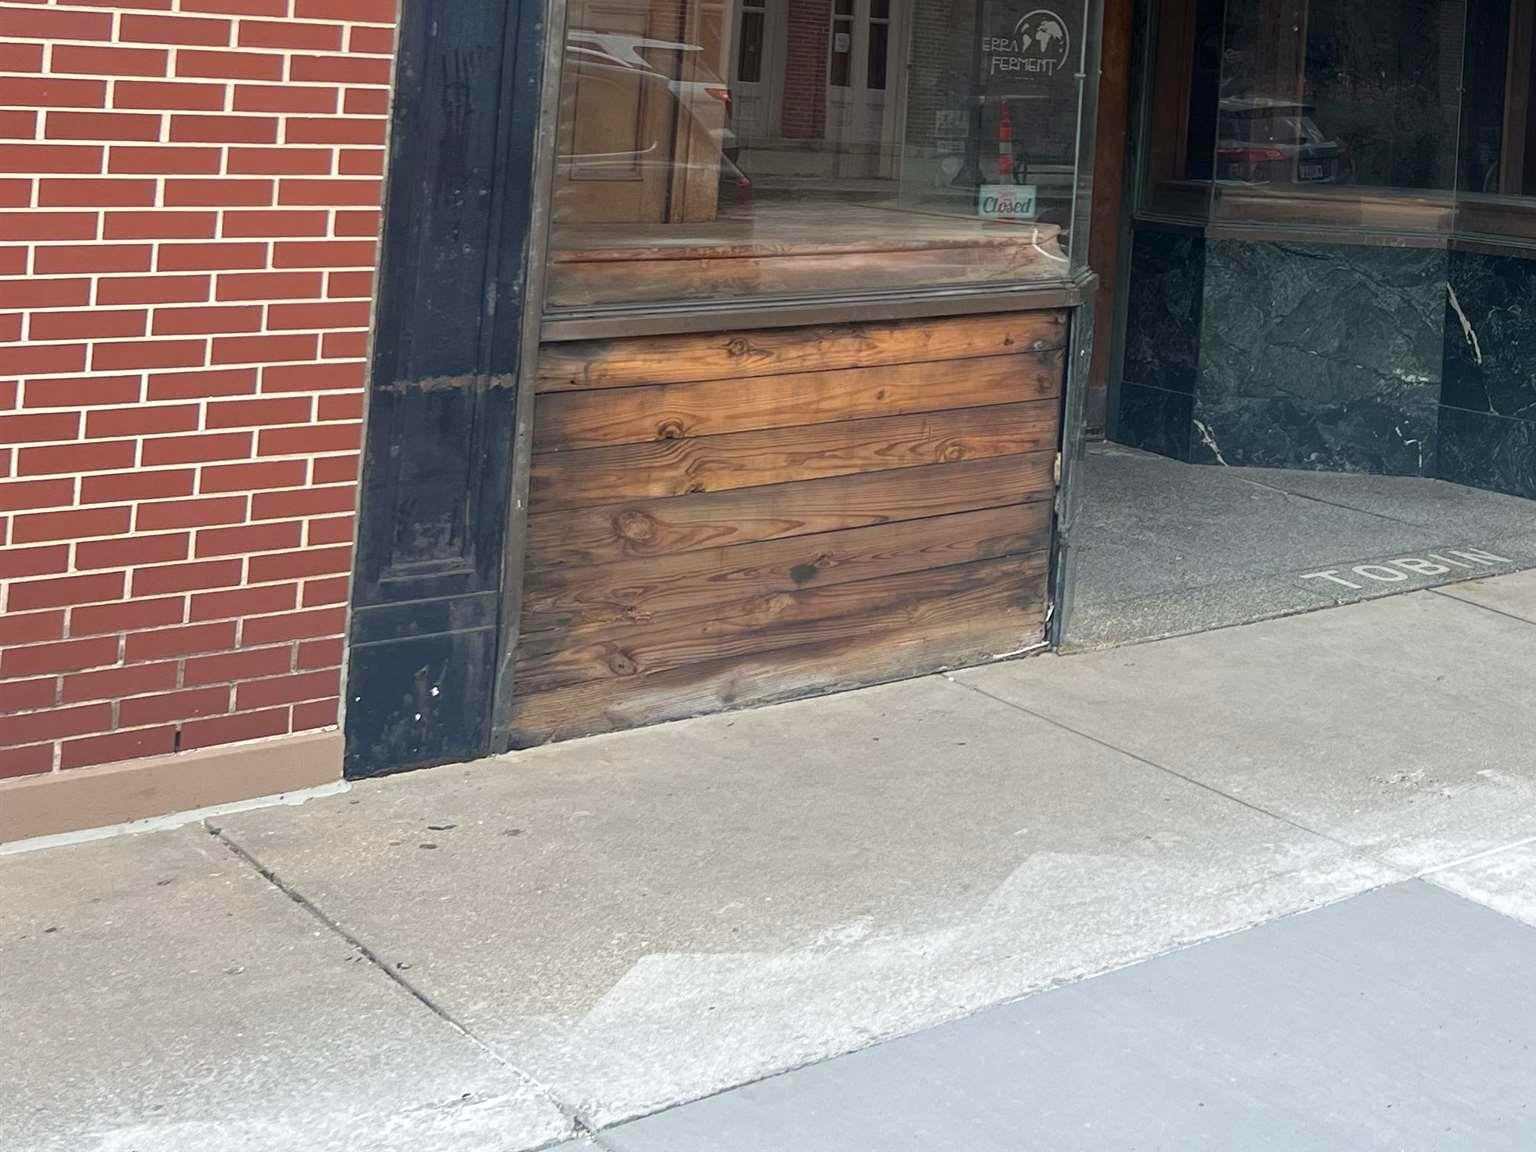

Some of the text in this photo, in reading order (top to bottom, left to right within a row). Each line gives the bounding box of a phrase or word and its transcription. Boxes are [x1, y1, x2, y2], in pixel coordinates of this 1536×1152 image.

[989, 55, 1057, 77] FERMENT
[982, 195, 1032, 215] Closed
[1300, 547, 1513, 590] TOBIN
